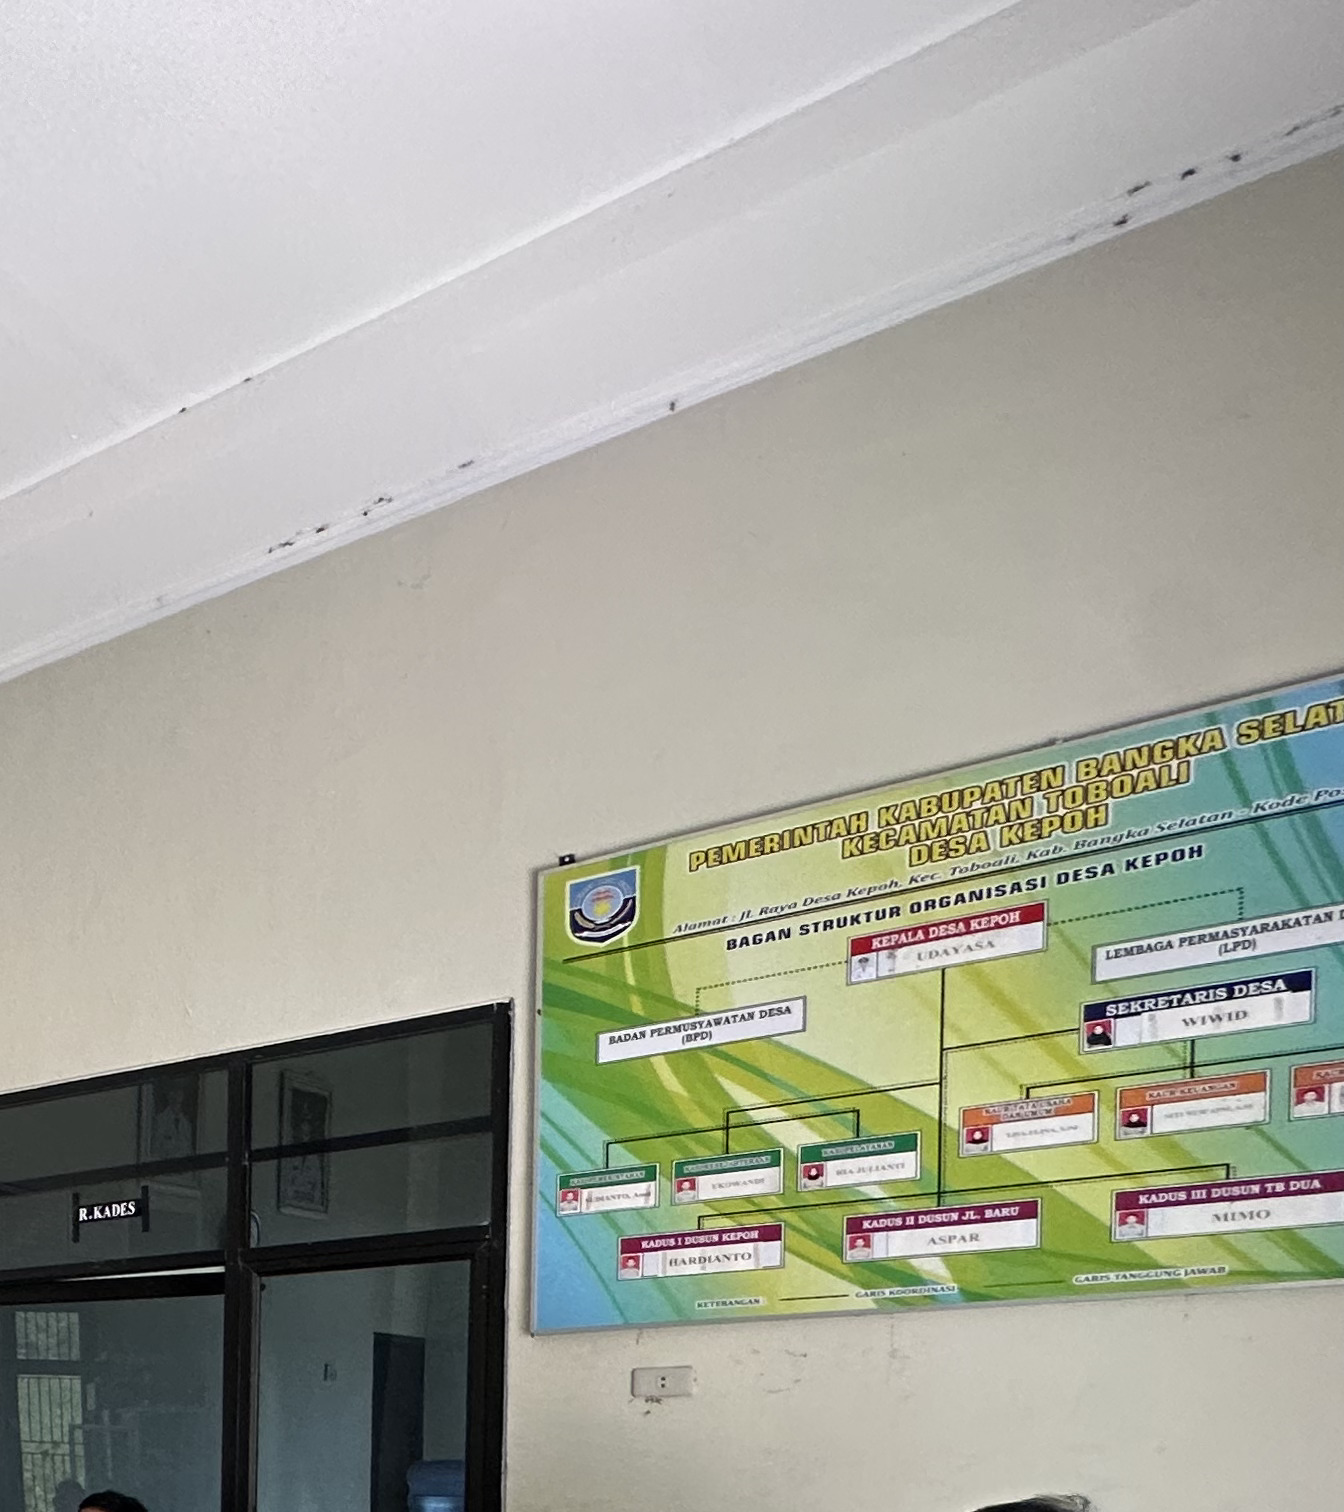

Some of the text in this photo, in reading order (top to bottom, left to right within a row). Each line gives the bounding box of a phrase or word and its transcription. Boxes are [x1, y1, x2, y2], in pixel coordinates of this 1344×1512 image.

[689, 811, 868, 873] PEMERINTAH
[877, 765, 1065, 828] KABUPATEN
[1075, 726, 1227, 783] BANGKA
[841, 760, 1191, 859] KECAMATAN TOBOALI
[909, 803, 1108, 867] DESA KEPOH
[672, 916, 728, 933] Alamat
[759, 901, 798, 918] Raya
[802, 892, 841, 906] Desa
[1073, 827, 1149, 851] Bangka
[1154, 809, 1233, 833] Selatan
[1251, 793, 1309, 815] Kode
[1313, 788, 1344, 801] Po
[726, 845, 1204, 951] BAGAN STRUKTUR ORGANISASI DESA KEPOH
[871, 910, 1021, 950] KEPALA DESA KEPOH
[1105, 910, 1334, 961] LEMBAGA PERMASYARAKATAN
[1218, 937, 1257, 957] (LPD)
[1105, 978, 1287, 1017] SEKRETARIS DESA
[608, 1005, 792, 1046] BADAN PERMUSYAWATAN DESA
[1181, 1009, 1248, 1028] WIWID
[681, 1030, 712, 1046] (BPD)
[1138, 1179, 1321, 1205] KADUS III DUSUN TB DUA
[78, 1200, 136, 1221] R.KADES
[862, 1206, 1020, 1229] KADUS II DUSUN JL. BARU
[1212, 1209, 1271, 1223] MIMO
[641, 1239, 675, 1249] KADUS
[685, 1234, 719, 1245] DUSUN
[722, 1230, 759, 1241] KEPOH
[927, 1233, 981, 1246] ASPAR
[669, 1252, 752, 1267] HARDIANTO
[1075, 1274, 1110, 1284] GARIS
[1183, 1265, 1226, 1278] JAWAB
